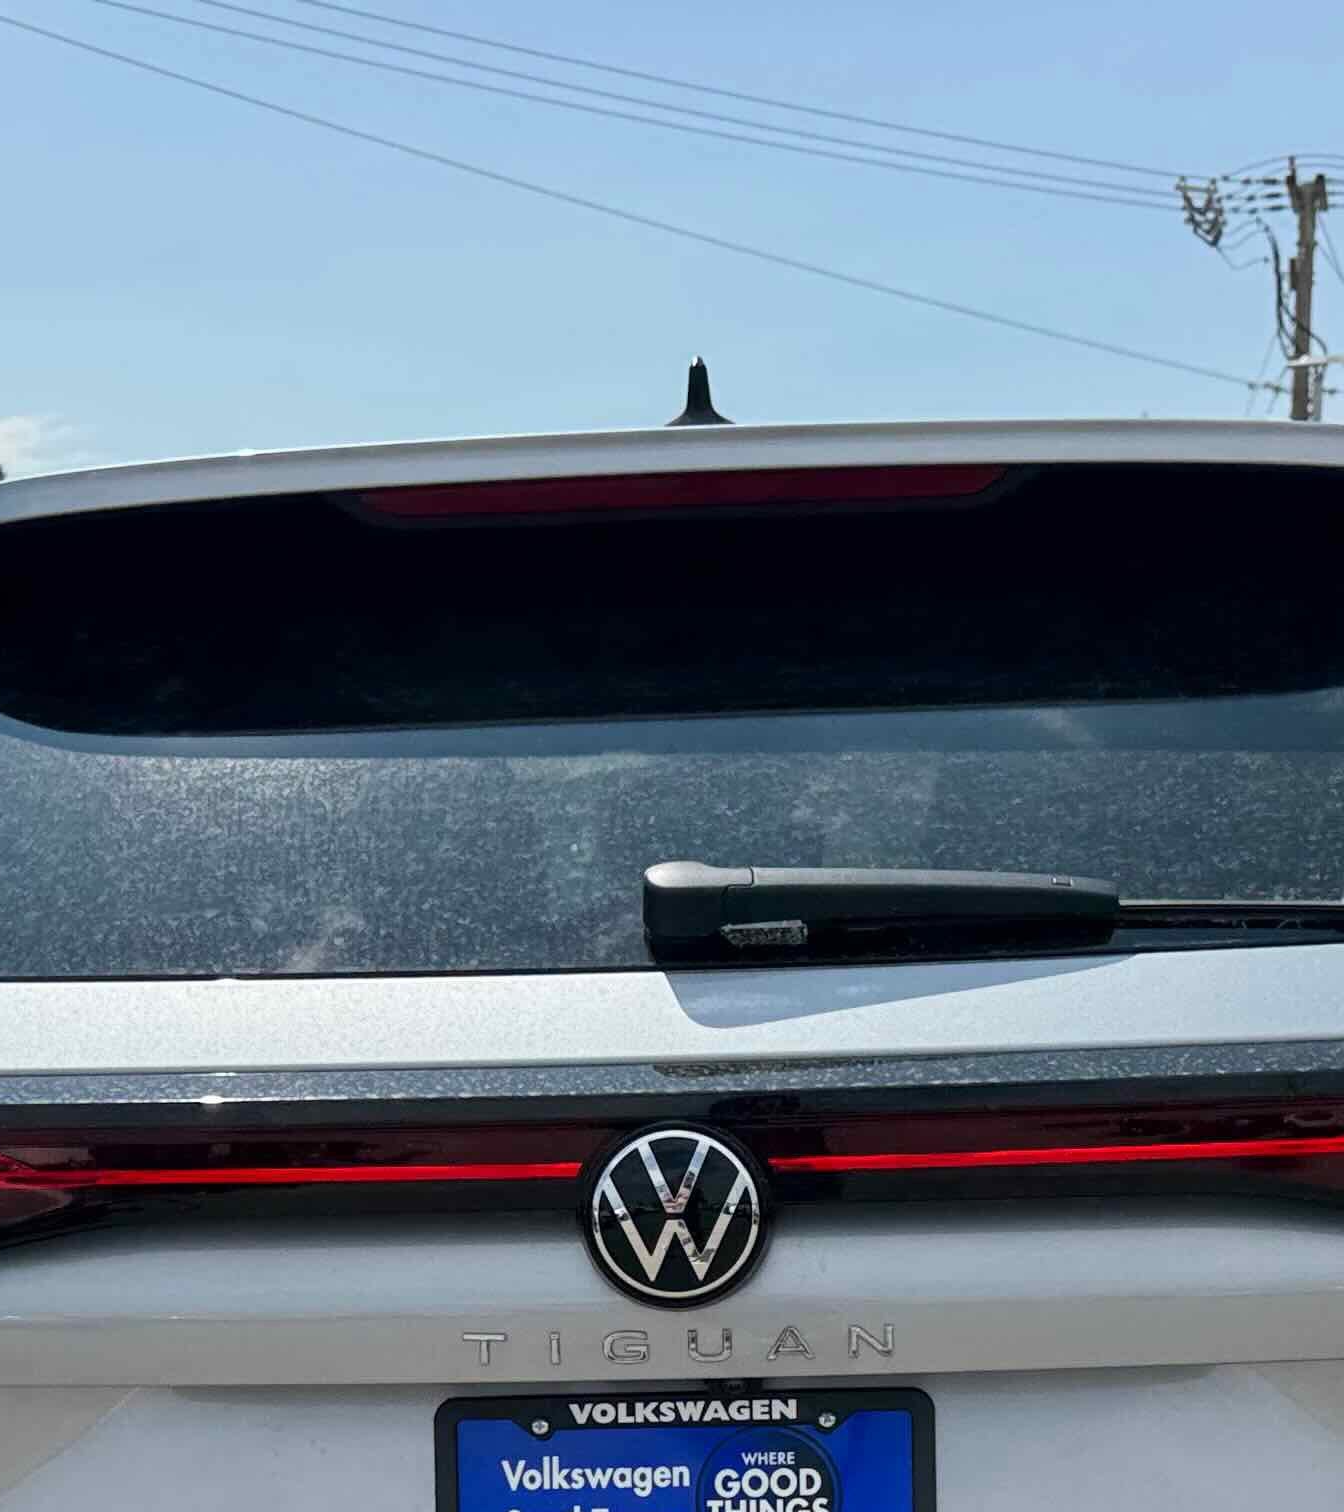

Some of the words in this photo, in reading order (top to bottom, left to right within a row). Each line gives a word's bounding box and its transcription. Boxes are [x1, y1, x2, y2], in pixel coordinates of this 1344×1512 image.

[595, 1132, 757, 1290] VW
[462, 1323, 896, 1366] TIGUAN
[569, 1399, 798, 1425] VOLKSWAGEN
[502, 1456, 691, 1497] Volkswagen
[741, 1451, 795, 1466] WHERE
[713, 1468, 822, 1499] GOOD
